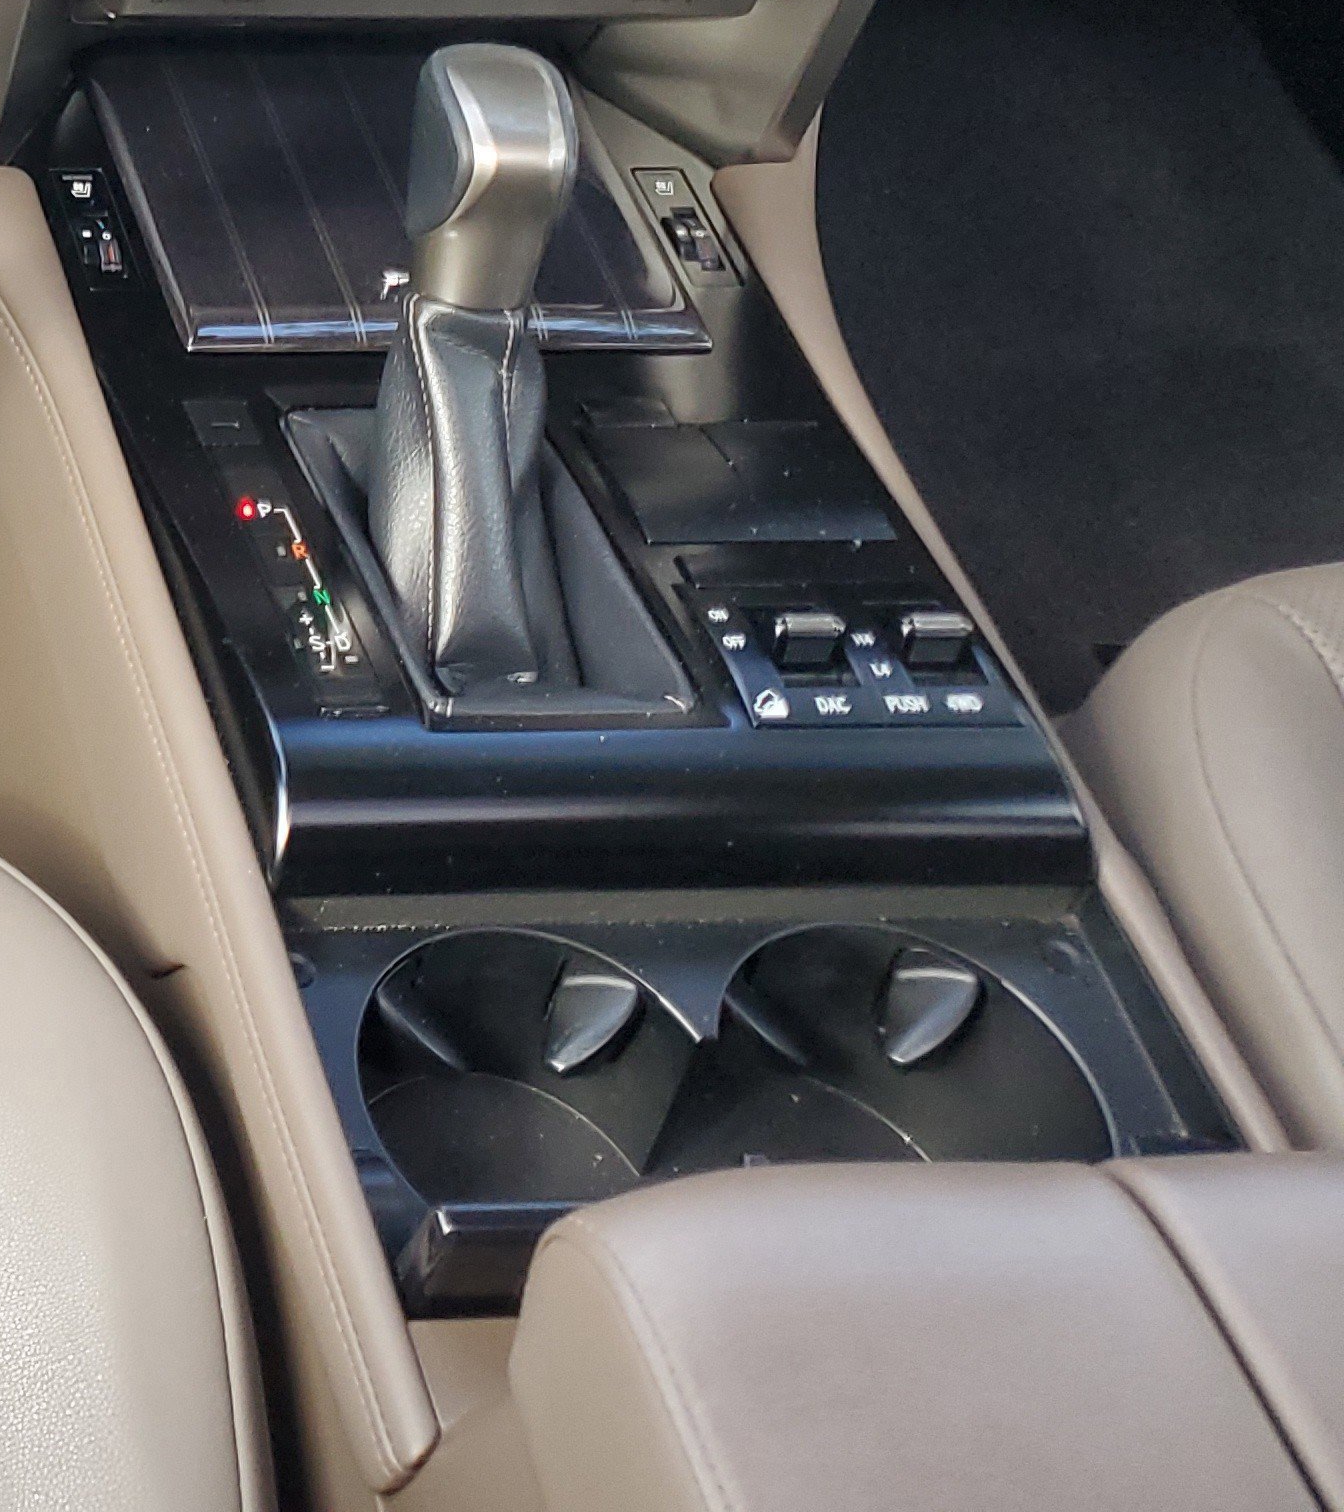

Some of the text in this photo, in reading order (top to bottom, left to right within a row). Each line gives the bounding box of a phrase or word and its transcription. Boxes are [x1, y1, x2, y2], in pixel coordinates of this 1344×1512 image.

[313, 588, 331, 605] N
[813, 694, 853, 716] DAC
[882, 694, 931, 714] PUSH
